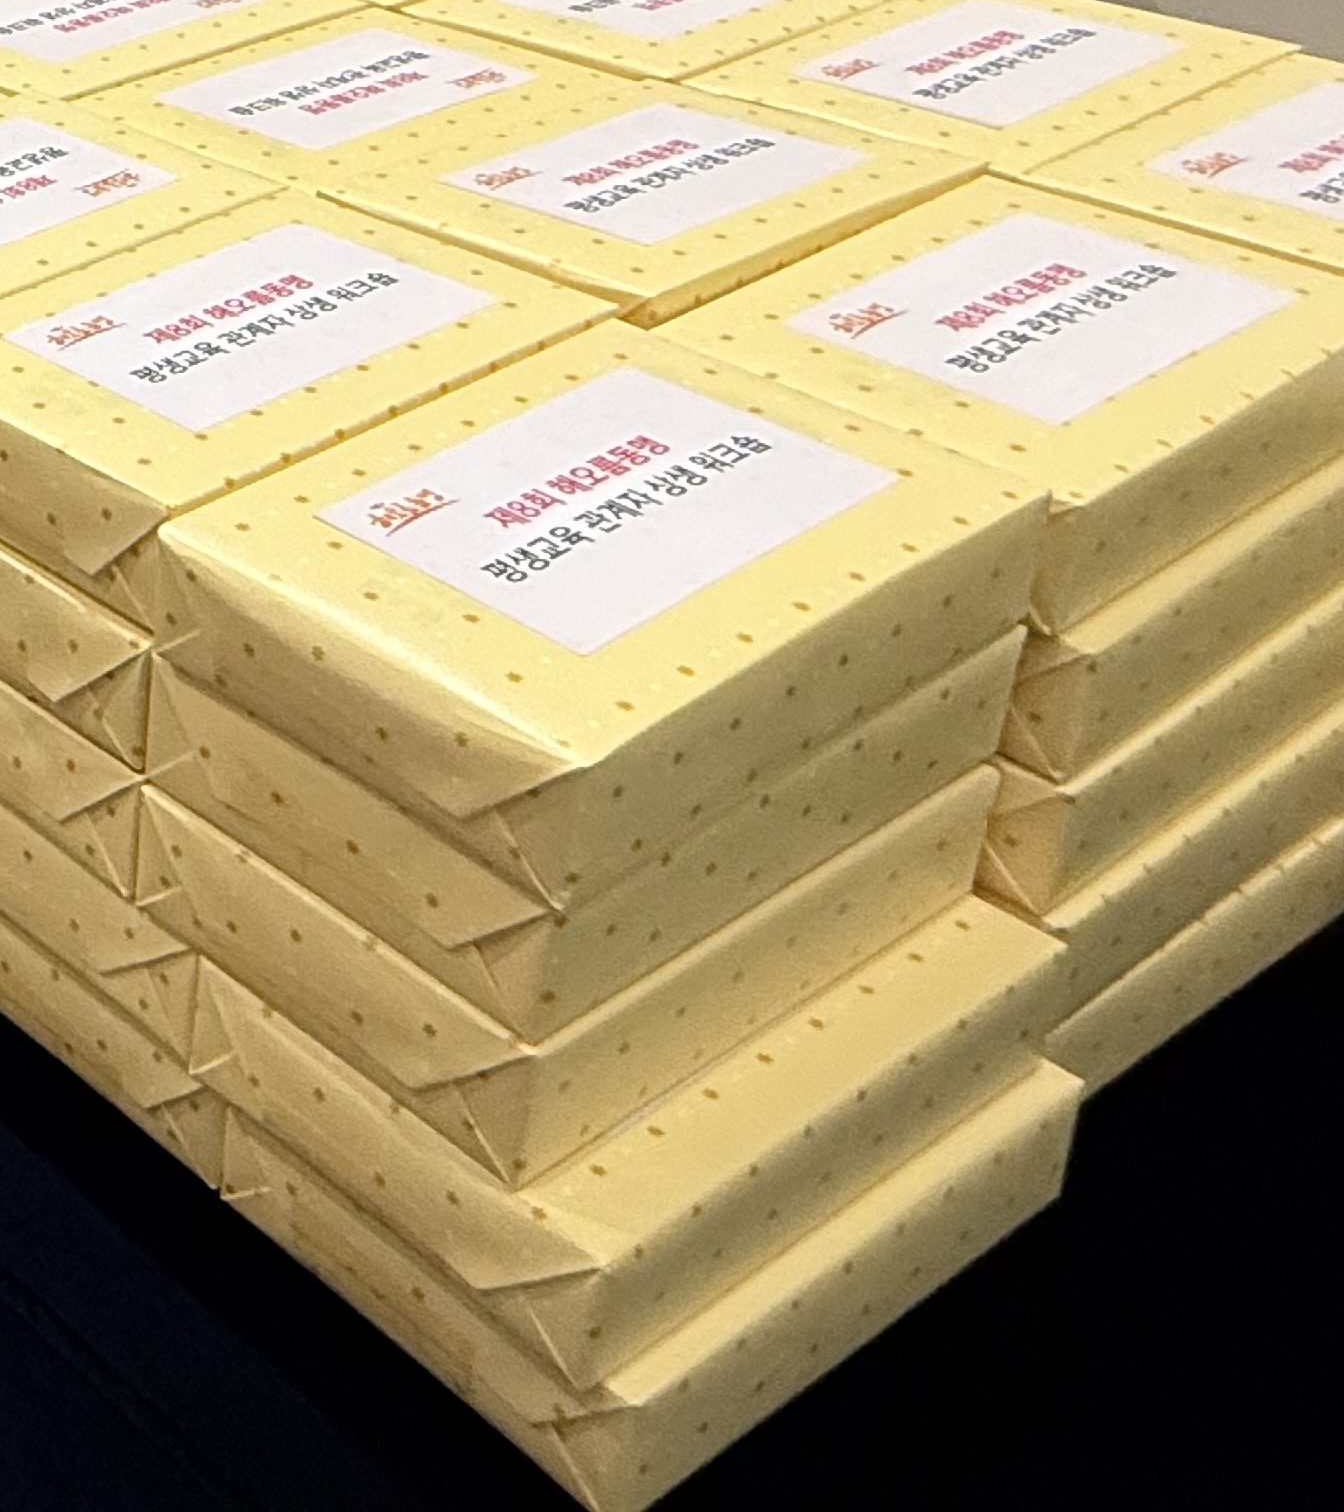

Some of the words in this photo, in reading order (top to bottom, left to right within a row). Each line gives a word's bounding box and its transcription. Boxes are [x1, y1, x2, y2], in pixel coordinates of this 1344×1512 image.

[129, 342, 230, 384] 평생교육
[217, 314, 294, 348] 관계자
[284, 296, 338, 320] 상생
[326, 272, 399, 302] 워크숍
[480, 526, 595, 583] 평생교육
[574, 488, 663, 534] 관계자
[644, 465, 708, 497] 상생
[688, 436, 772, 473] 워크숍
[483, 488, 566, 528] 제8회
[546, 435, 670, 495] 해오름동맹
